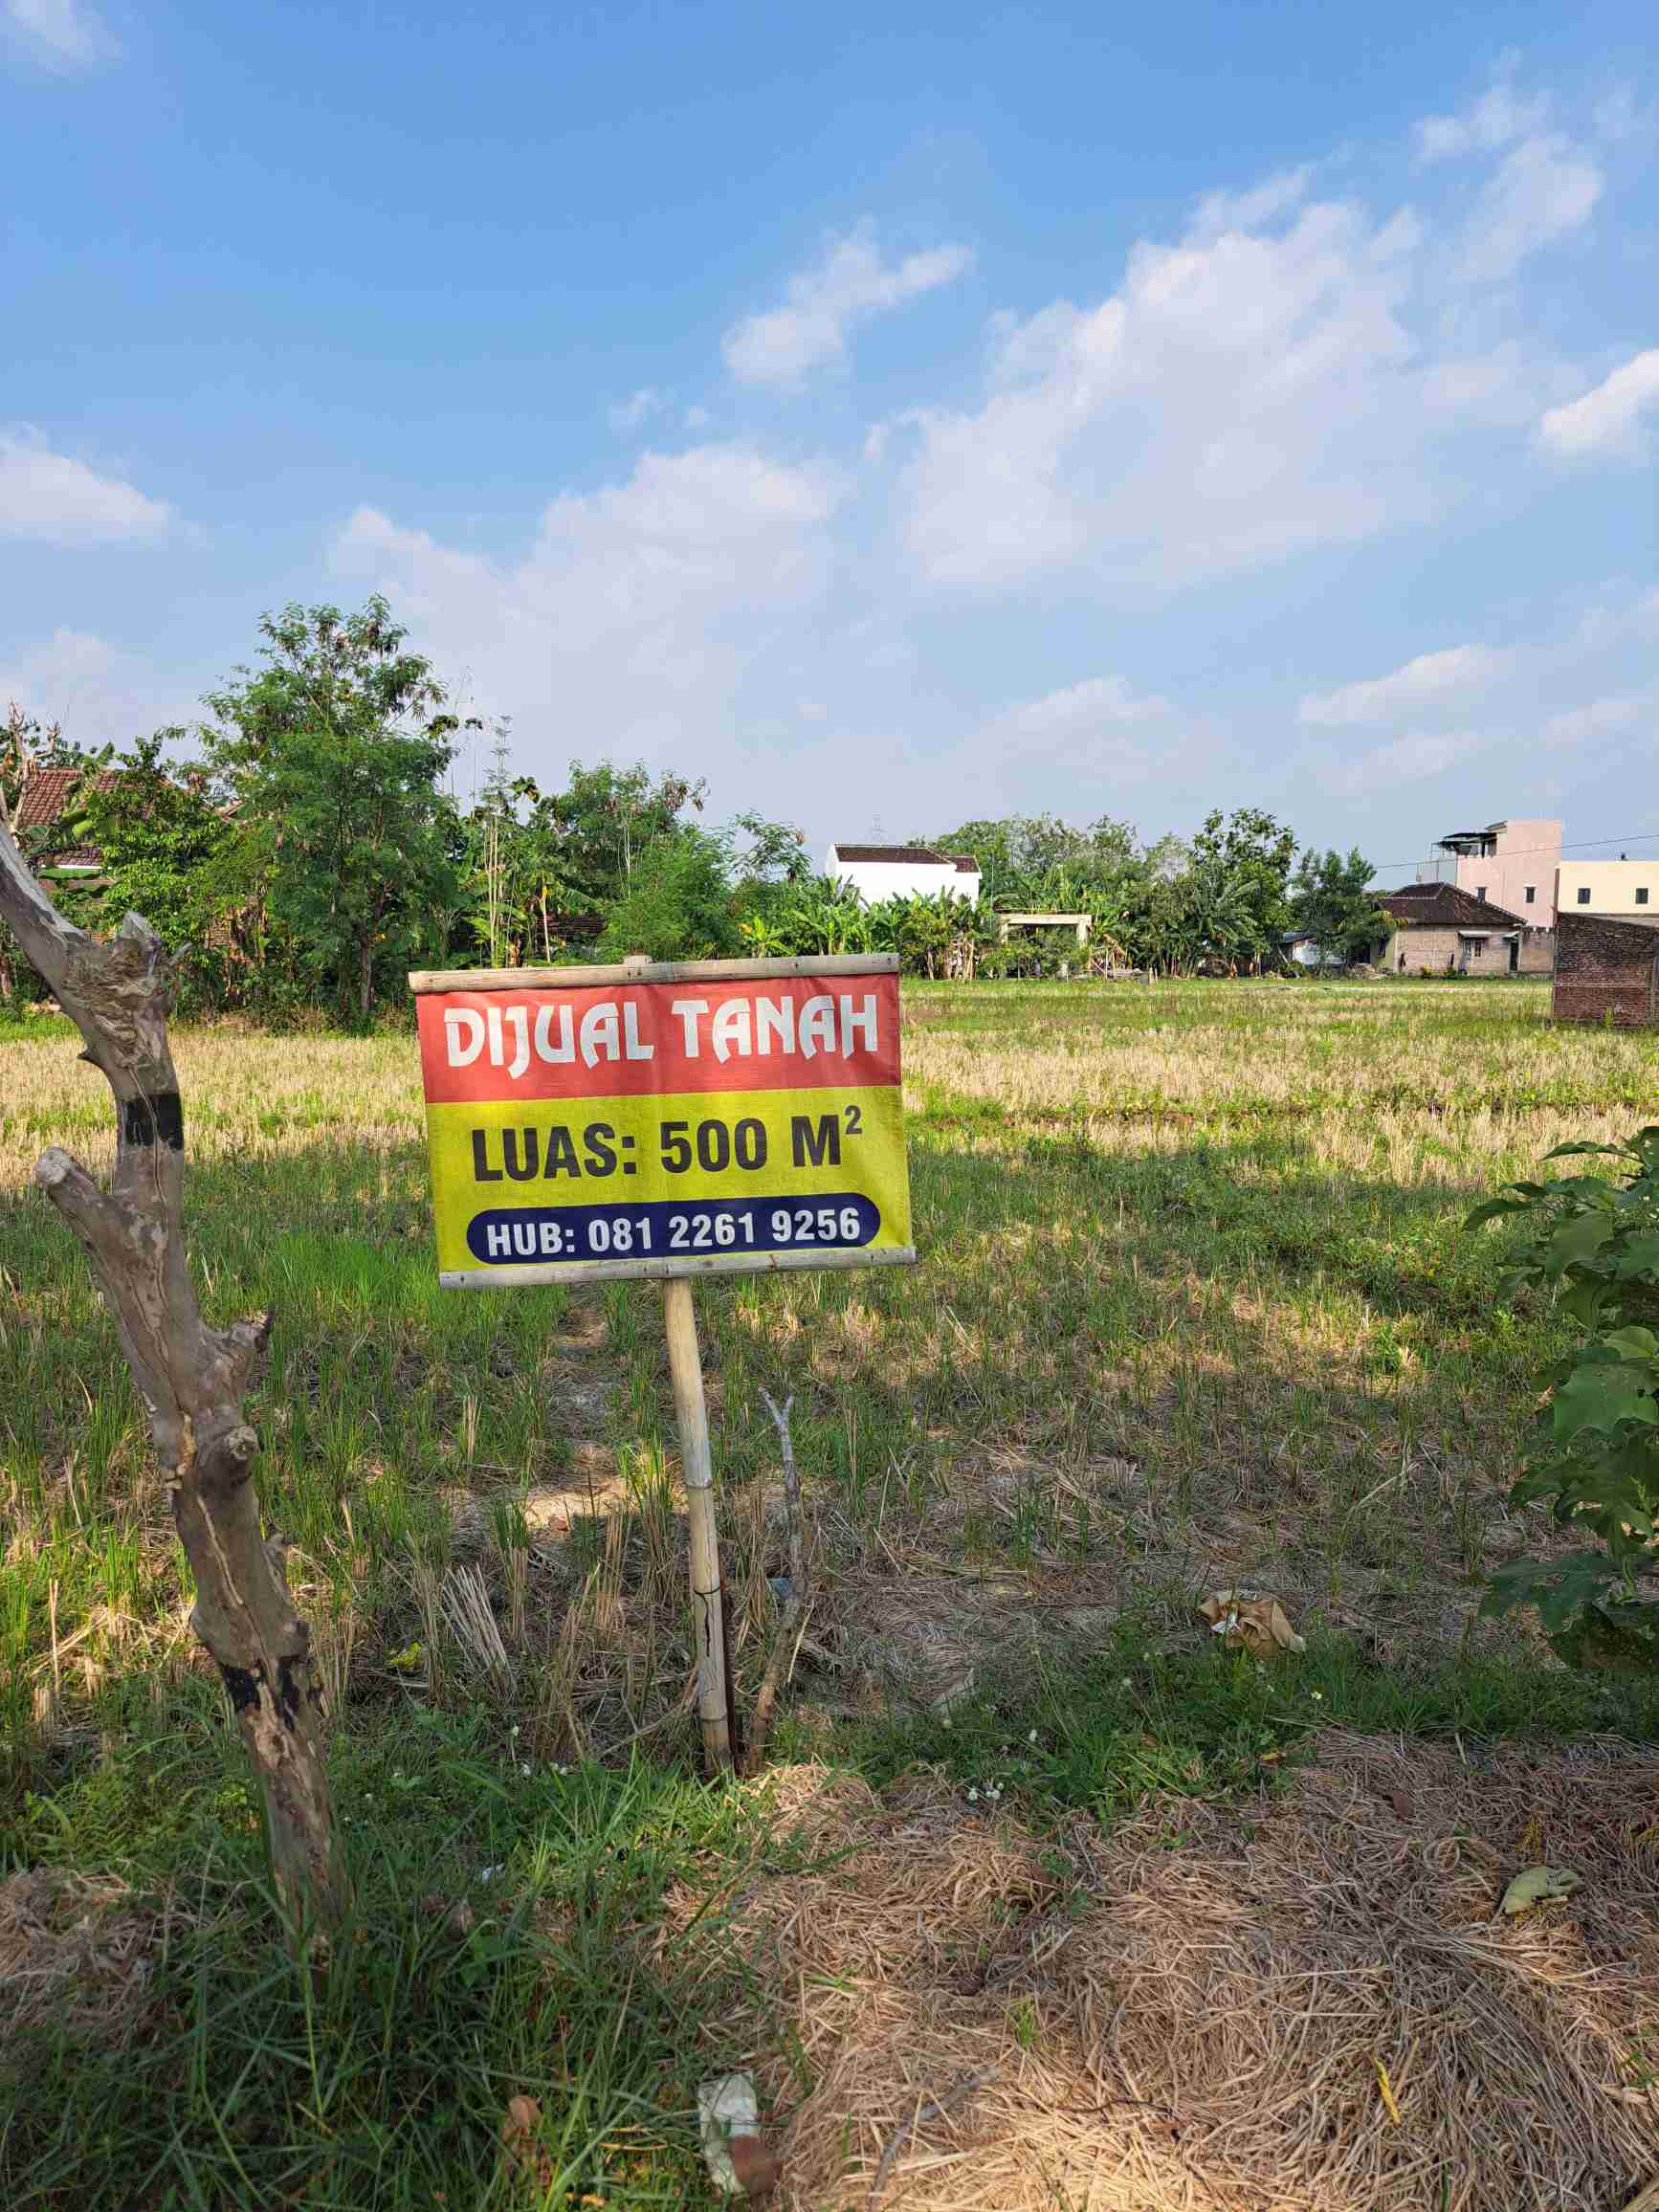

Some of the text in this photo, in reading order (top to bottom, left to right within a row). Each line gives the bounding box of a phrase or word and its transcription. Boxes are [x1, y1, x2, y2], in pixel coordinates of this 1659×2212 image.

[443, 994, 878, 1079] DIJUAL TANAH
[472, 1122, 636, 1182] LUAS:
[660, 1117, 766, 1173] 500
[486, 1207, 860, 1256] HUB: 081 2261 9256
